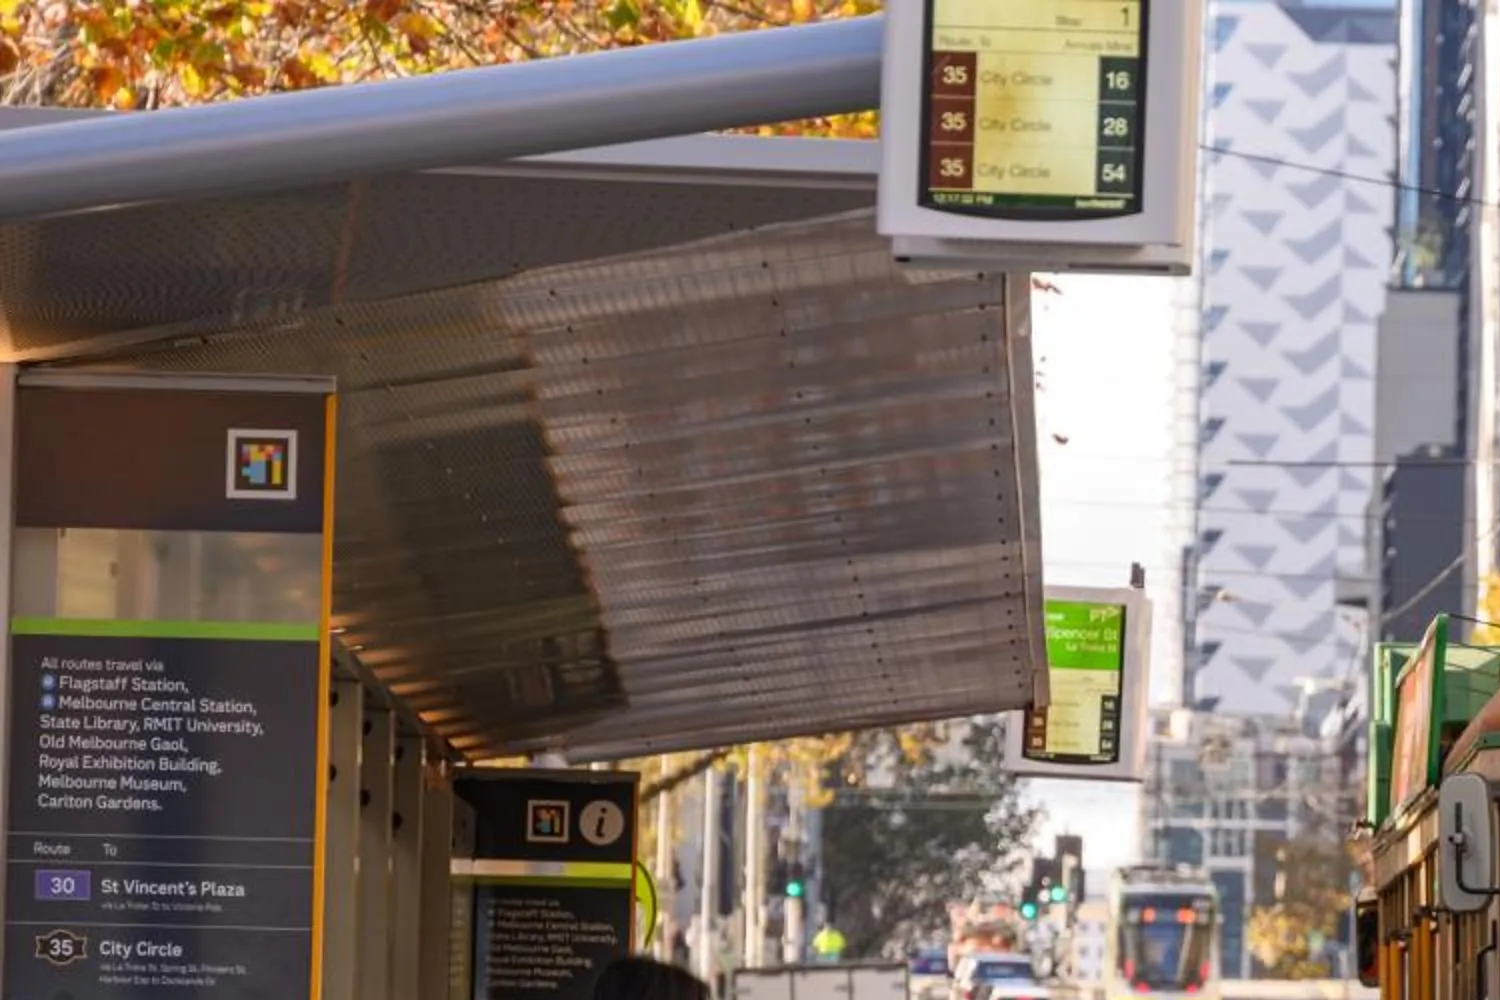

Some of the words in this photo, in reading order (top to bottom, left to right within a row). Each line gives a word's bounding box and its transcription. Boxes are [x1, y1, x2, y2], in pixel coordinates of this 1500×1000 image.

[1121, 7, 1130, 27] 1
[943, 65, 968, 84] 35
[981, 70, 1007, 87] City
[1011, 71, 1053, 86] Circle
[1106, 71, 1130, 90] 16
[941, 111, 967, 131] 35
[979, 116, 1006, 133] City
[1010, 117, 1052, 131] Circle
[1103, 117, 1128, 137] 28
[939, 157, 965, 177] 35
[977, 162, 1004, 180] City
[1009, 163, 1051, 178] Circle
[1101, 163, 1126, 182] 54
[41, 656, 58, 669] All
[61, 658, 102, 671] routes
[105, 659, 142, 672] travel
[145, 658, 164, 672] via
[59, 675, 128, 693] Flagstaff
[131, 676, 189, 694] Station,
[58, 694, 138, 711] Melbourne
[141, 696, 196, 712] Central
[199, 697, 257, 717] Station,
[39, 713, 80, 729] State
[83, 715, 141, 735] Library,
[143, 716, 182, 732] RMIT
[186, 717, 265, 737] University,
[39, 734, 65, 749] Old
[68, 734, 147, 750] Melbourne
[150, 736, 190, 753] Gaol,
[39, 753, 79, 772] Royal
[82, 754, 156, 771] Exhibition
[158, 756, 223, 776] Building,
[38, 773, 117, 789] Melbourne
[119, 774, 188, 793] Museum,
[38, 792, 93, 809] Carlton
[33, 840, 72, 856] Route
[103, 842, 118, 857] To
[51, 876, 76, 895] 30
[101, 879, 120, 895] St
[123, 880, 198, 896] Vincent's
[201, 880, 246, 898] Plaza
[50, 938, 74, 956] 35
[99, 940, 132, 959] City
[136, 940, 183, 958] Circle
